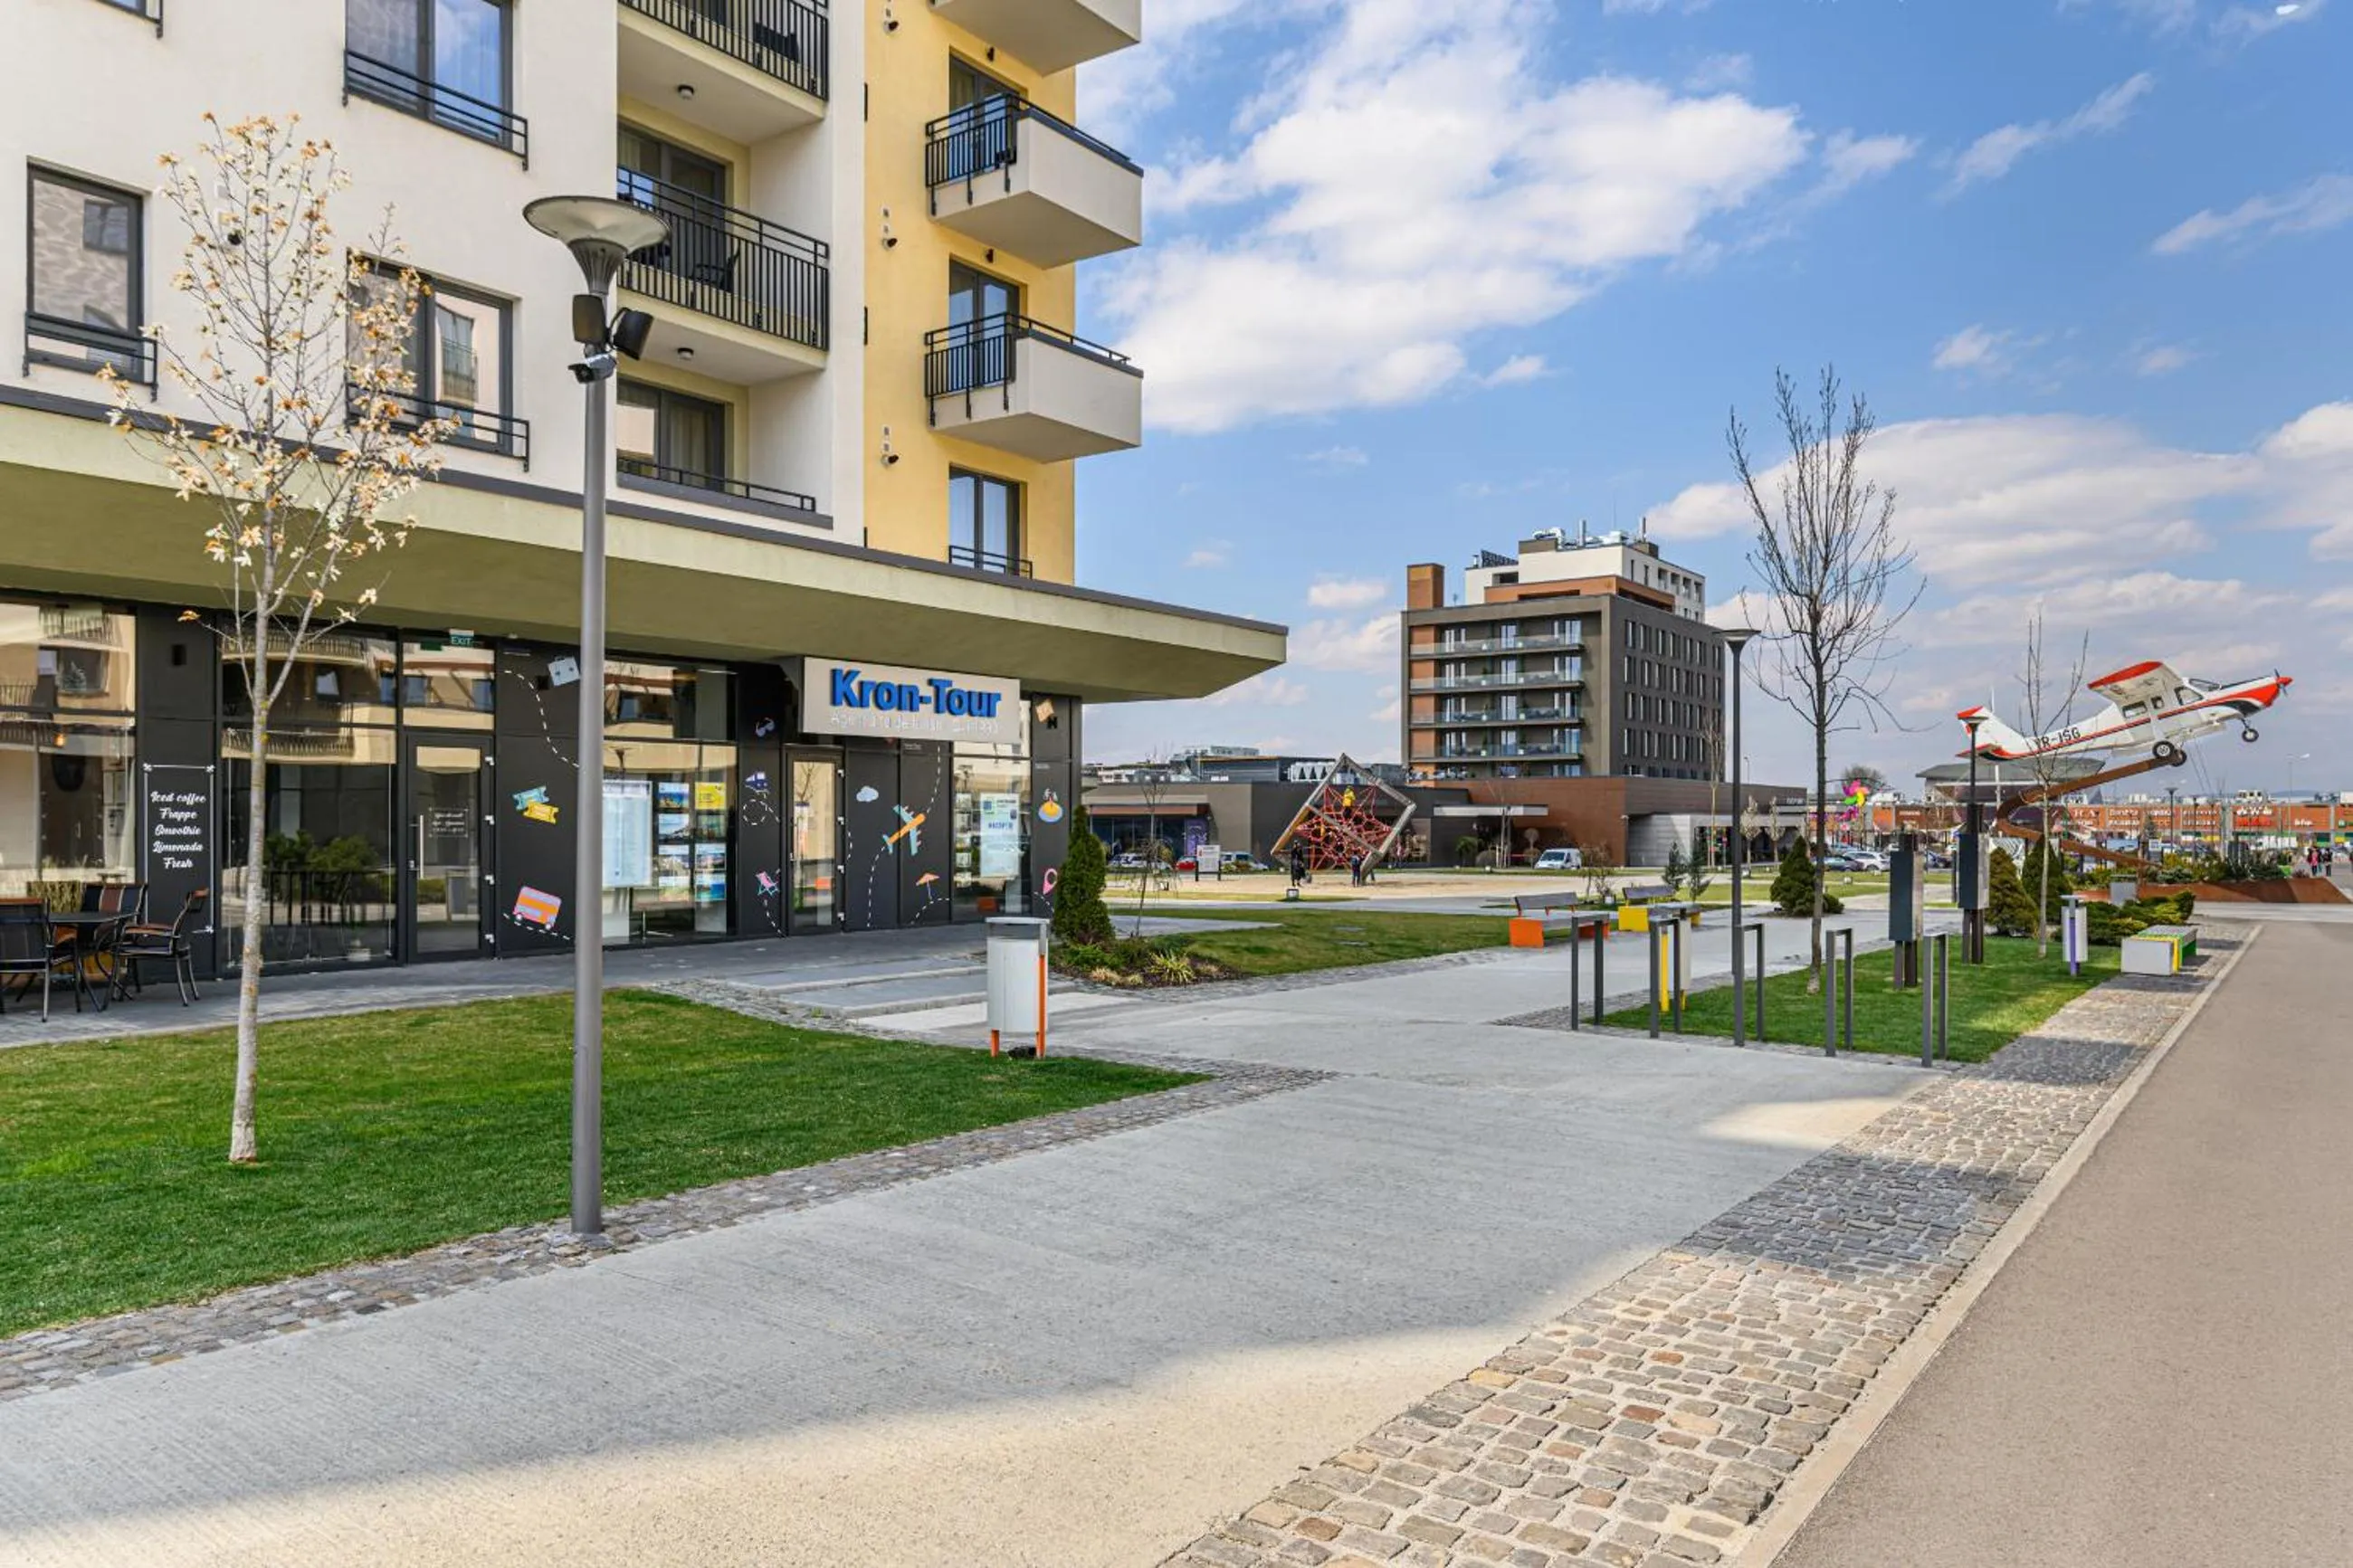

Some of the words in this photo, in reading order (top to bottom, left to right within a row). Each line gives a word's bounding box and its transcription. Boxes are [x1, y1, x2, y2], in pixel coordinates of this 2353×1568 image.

[451, 636, 471, 645] EXIT
[830, 668, 1002, 717] Kron-Tour
[150, 791, 175, 803] Iced
[176, 793, 206, 805] coffee
[159, 807, 197, 822] Frappe
[155, 824, 201, 836] Smoothie
[152, 840, 204, 853] Limonada
[163, 857, 193, 869] Fresh
